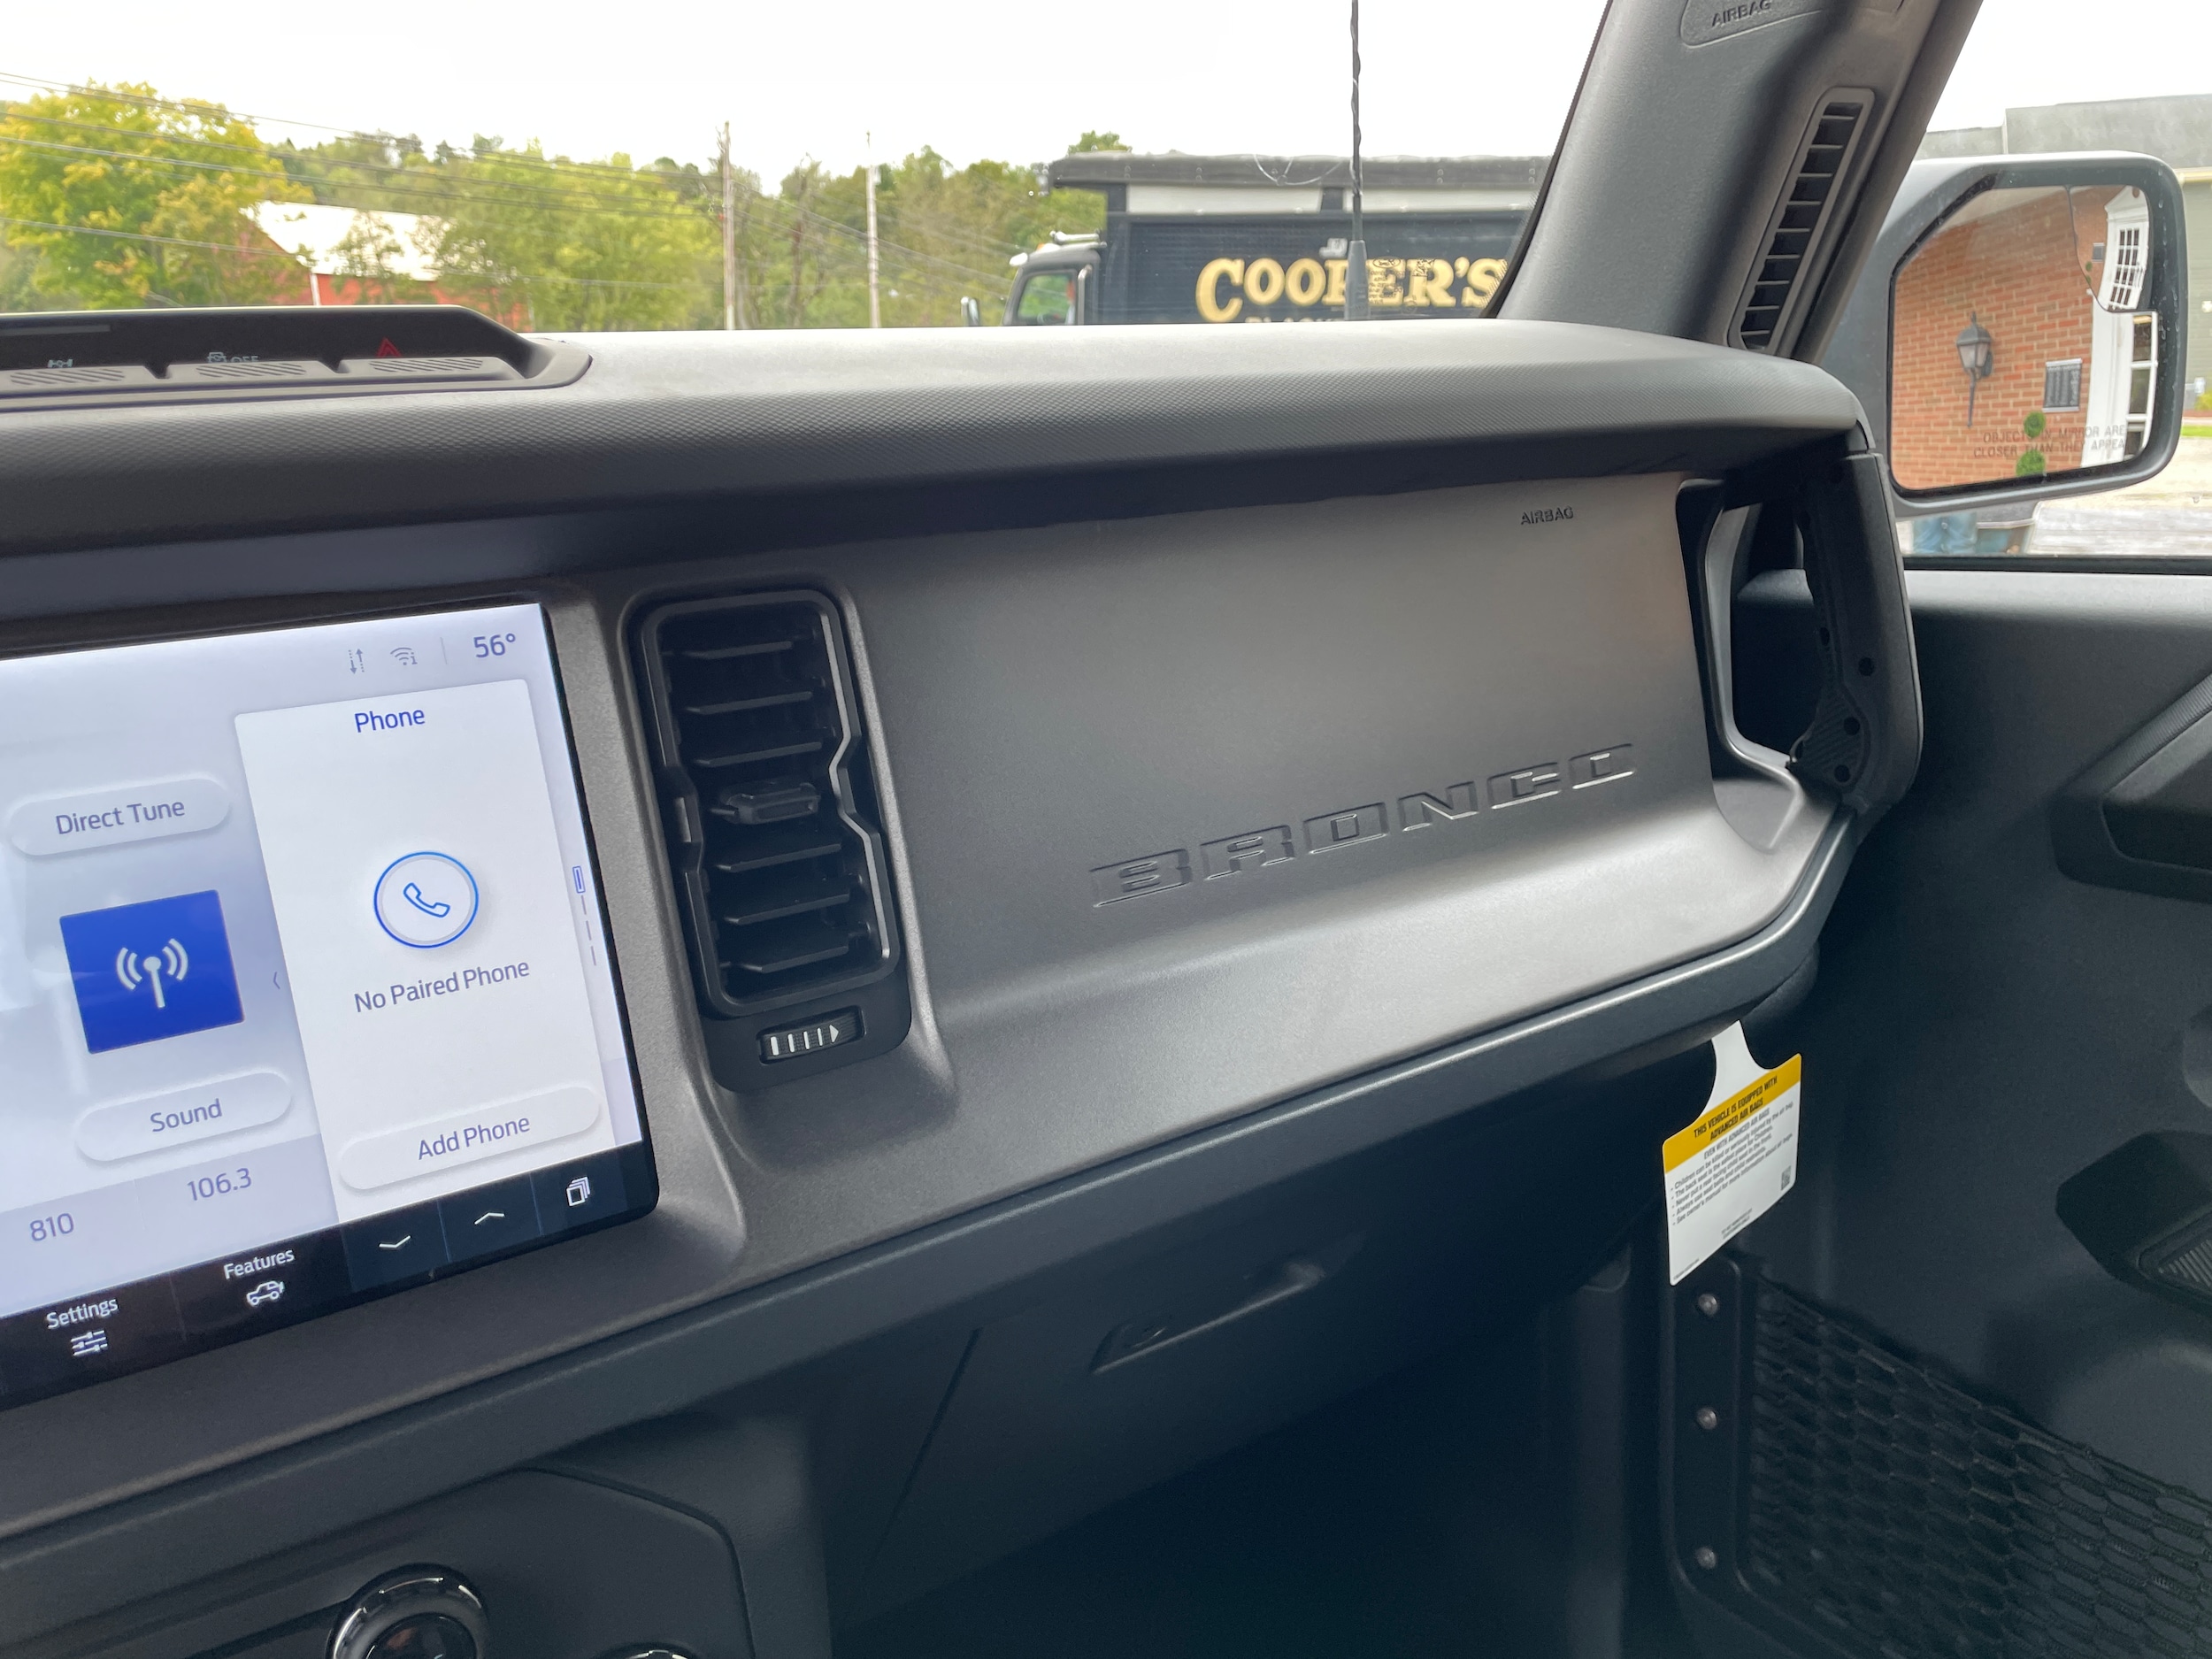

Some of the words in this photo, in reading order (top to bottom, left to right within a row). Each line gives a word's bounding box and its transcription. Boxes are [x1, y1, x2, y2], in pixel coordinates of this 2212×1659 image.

[1712, 0, 1770, 27] AIRBAG
[1973, 445, 2018, 458] CLOSER
[2091, 438, 2124, 451] APPEA
[1983, 429, 2028, 443] OBJECT
[2104, 425, 2125, 436] ARE
[1521, 505, 1574, 525] AIRBAG
[354, 707, 426, 733] Phone
[56, 807, 125, 835] Direct
[126, 799, 186, 824] Tune
[1089, 743, 1635, 908] BRONCO
[354, 991, 387, 1013] No
[390, 972, 460, 1005] Paired
[463, 962, 530, 989] Phone
[150, 1098, 222, 1133] Sound
[1694, 1123, 1708, 1138] THIS
[1708, 1108, 1730, 1129] VEHICLE
[1731, 1104, 1737, 1115] IS
[1738, 1086, 1763, 1110] EQUIPPED
[1763, 1076, 1778, 1091] WITH
[419, 1131, 460, 1161] Add
[463, 1118, 530, 1148] Phone
[1709, 1117, 1739, 1141] ADVANCED
[1740, 1109, 1749, 1121] AIR
[187, 1167, 251, 1202] 106.3
[29, 1213, 74, 1241] 810
[223, 1249, 295, 1279] Features
[46, 1299, 119, 1329] Settings
